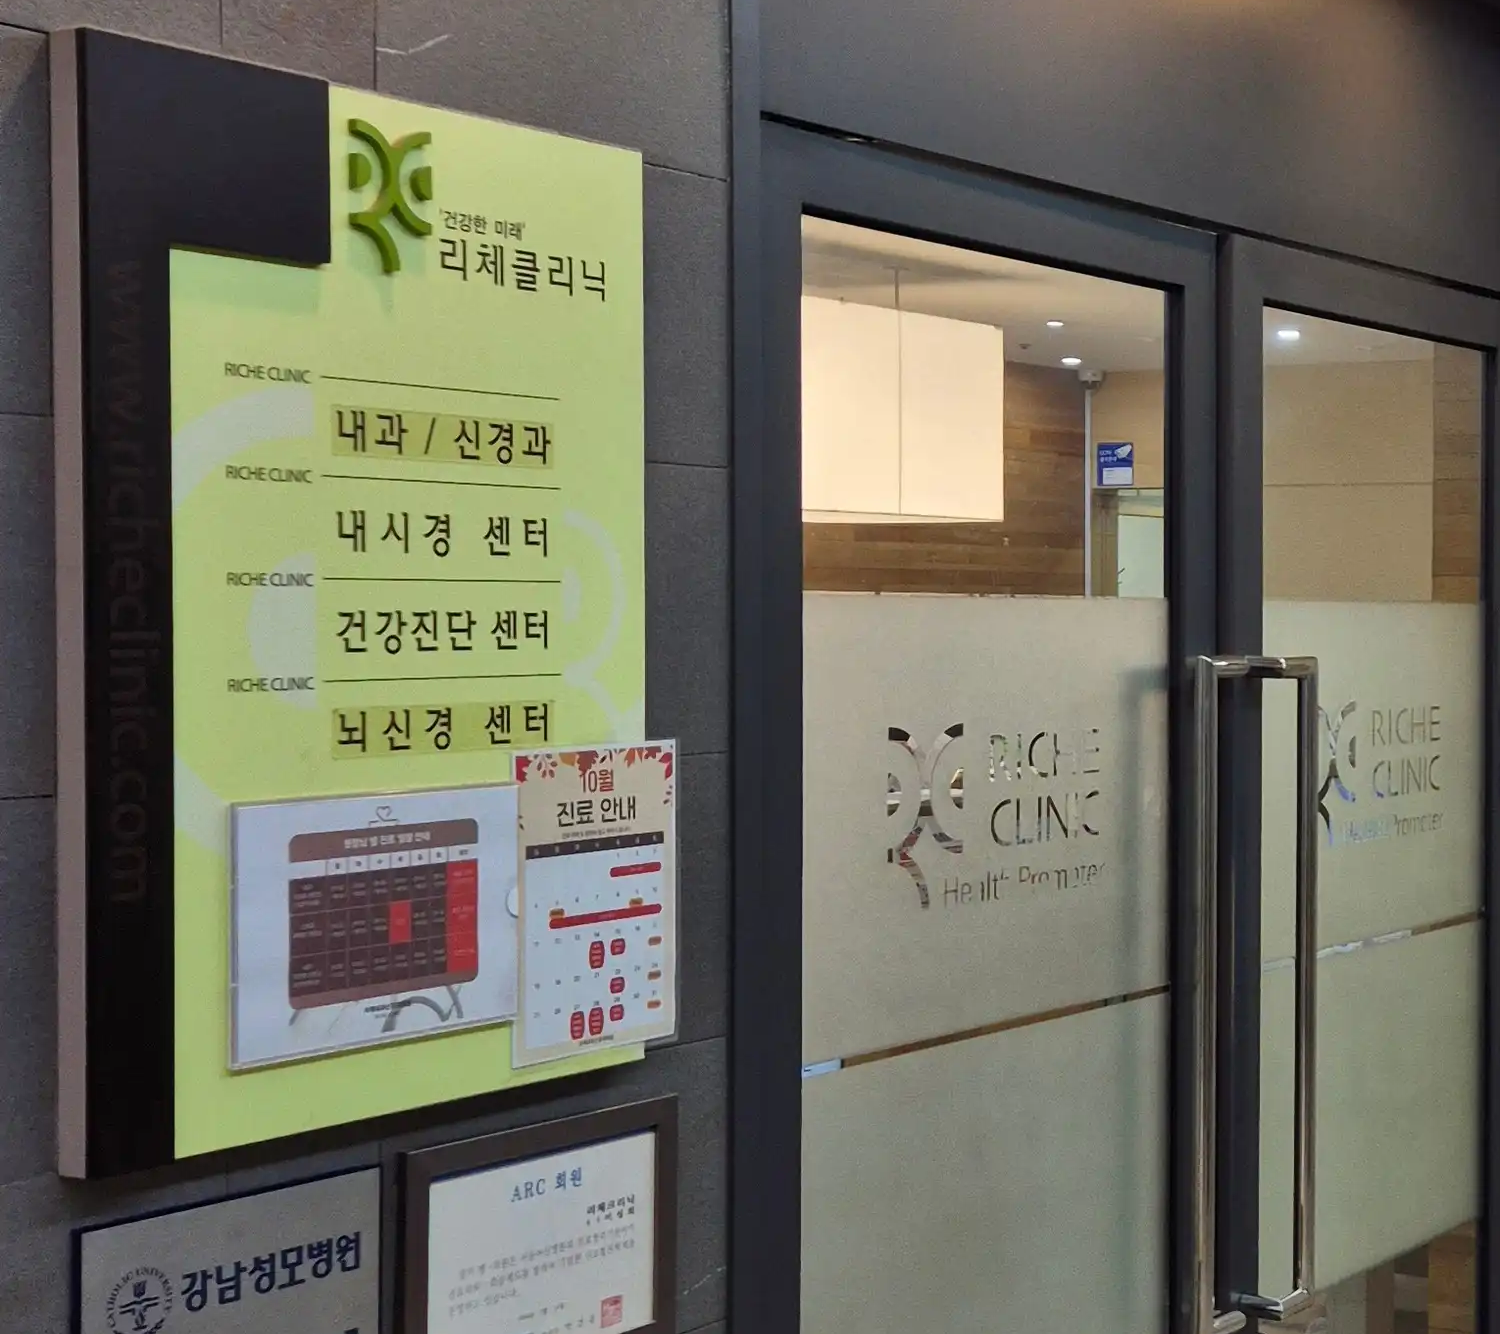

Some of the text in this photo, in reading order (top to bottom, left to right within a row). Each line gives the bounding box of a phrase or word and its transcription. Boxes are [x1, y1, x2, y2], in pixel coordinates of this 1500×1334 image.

[439, 238, 606, 302] 리체클리닉
[224, 362, 312, 383] RICHE CLINIC
[336, 410, 409, 455] 내과
[453, 419, 552, 465] 신경과
[225, 465, 313, 483] RICHE CLINIC
[336, 510, 549, 558] 내시경 센터
[106, 258, 162, 903] www.richeclinic.com
[226, 572, 314, 587] RICHE CLINIC
[336, 610, 549, 655] 건강진단 센터
[227, 677, 316, 692] RICHE CLINIC
[337, 702, 549, 751] 뇌신경 센터
[1372, 705, 1442, 747] RICHE
[988, 727, 1101, 783] RICHE
[1373, 754, 1442, 798] CLINIC
[580, 769, 615, 794] 10월
[556, 795, 637, 828] 진료 안내
[991, 790, 1101, 847] CLINIC
[511, 1167, 583, 1203] ARC 회원
[181, 1231, 361, 1312] 강남성모병원
